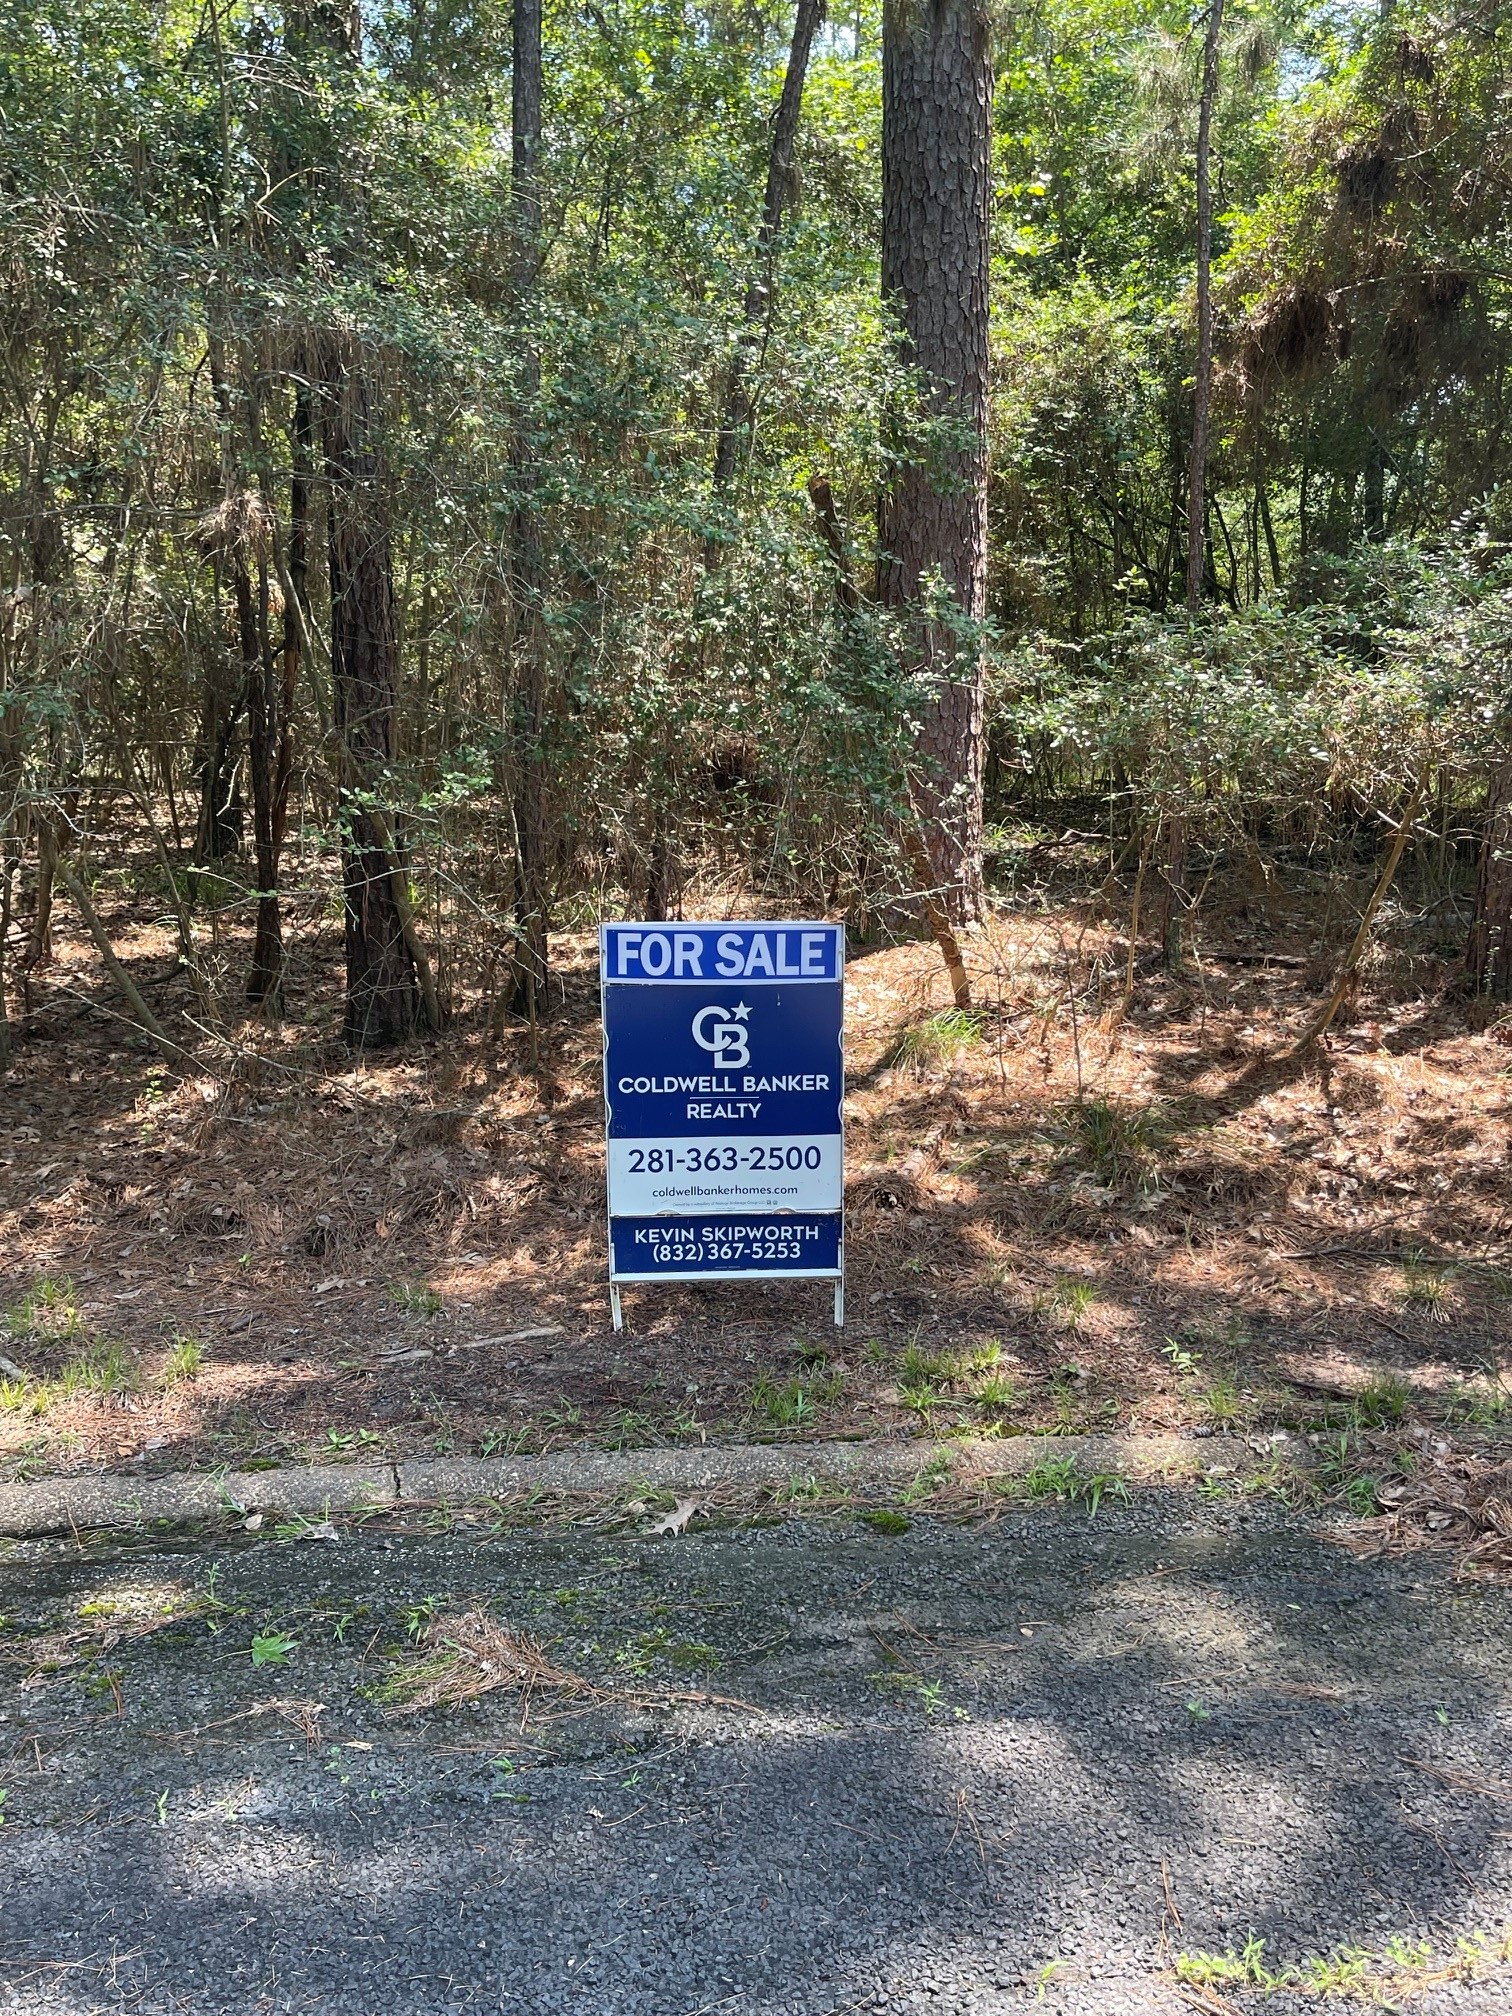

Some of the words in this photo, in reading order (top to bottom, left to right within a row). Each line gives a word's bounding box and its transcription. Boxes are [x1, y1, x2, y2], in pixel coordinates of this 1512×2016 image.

[617, 932, 704, 977] FOR
[714, 932, 826, 977] SALE
[618, 1076, 736, 1094] COLDWELL
[743, 1074, 830, 1092] BANKER
[686, 1103, 762, 1119] REALTY
[628, 1145, 822, 1173] 281-363-2500
[652, 1185, 798, 1198] coldwellbankerhomes.com
[634, 1227, 695, 1244] KEVIN
[701, 1225, 819, 1242] SKIPWORTH
[653, 1244, 704, 1263] (832)
[707, 1242, 801, 1260] 367-5253
